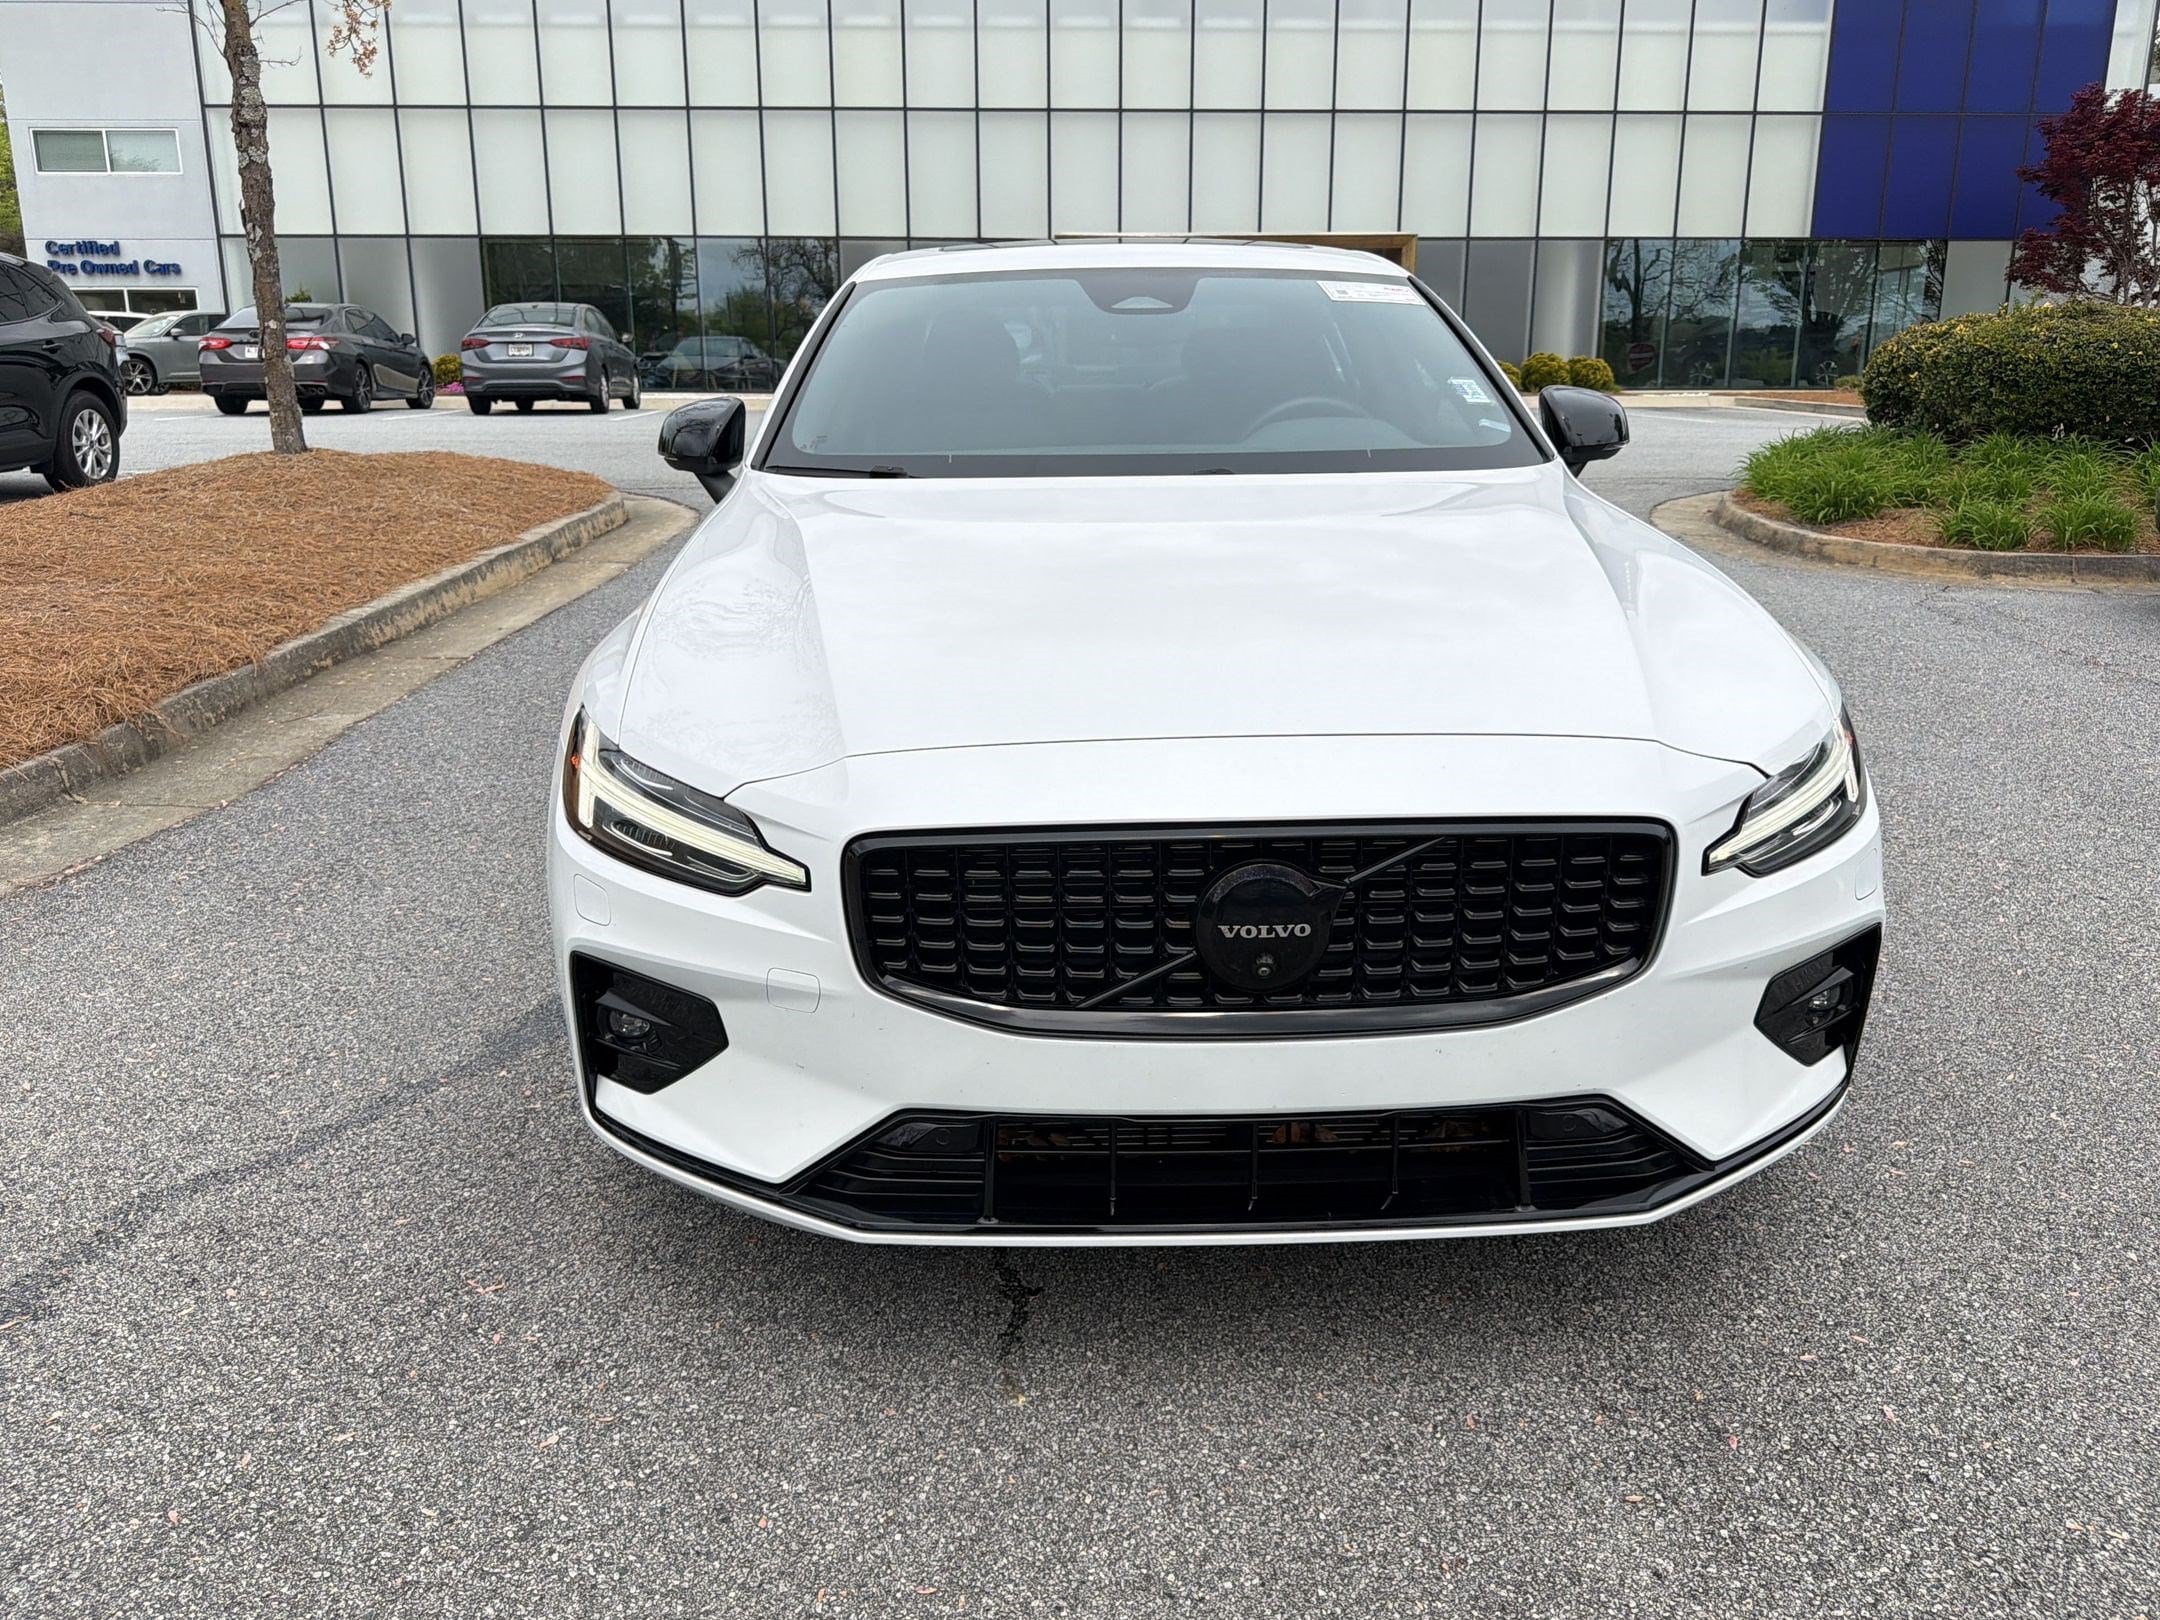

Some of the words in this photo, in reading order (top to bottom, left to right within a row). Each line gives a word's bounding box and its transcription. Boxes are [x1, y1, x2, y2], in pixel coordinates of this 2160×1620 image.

[45, 240, 120, 256] Certified
[47, 260, 78, 275] Pre
[80, 259, 139, 275] Owned
[143, 259, 182, 275] Cars
[1217, 923, 1312, 939] VOLVO
